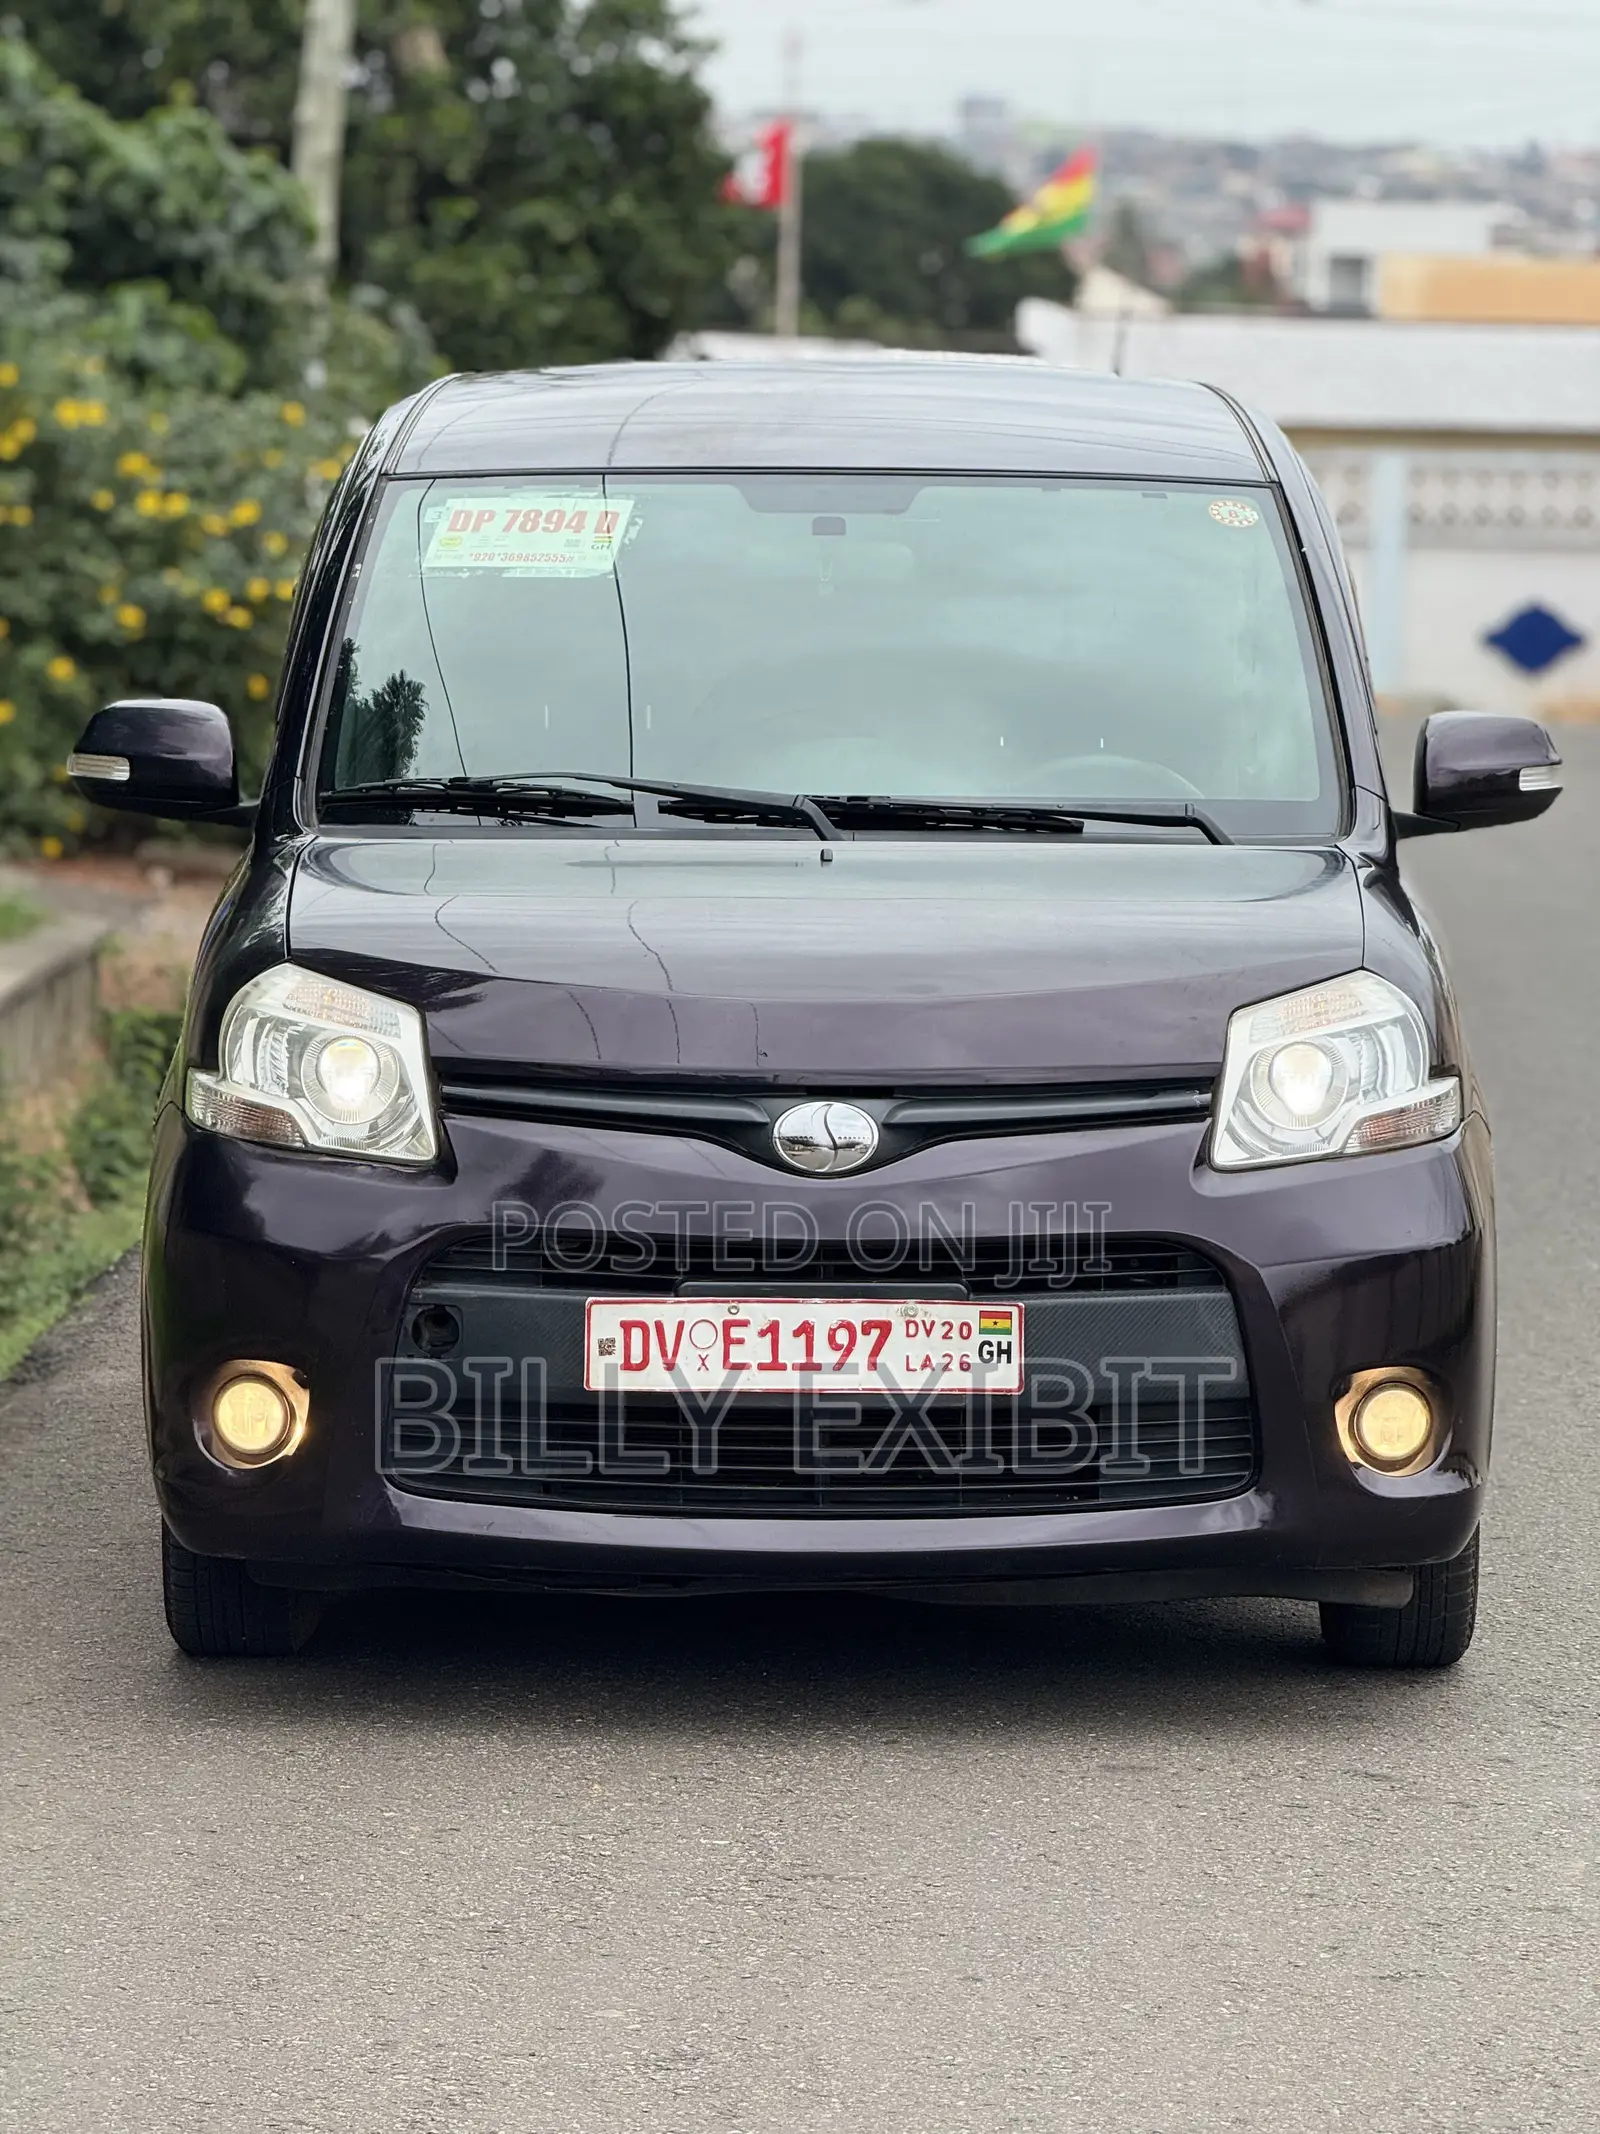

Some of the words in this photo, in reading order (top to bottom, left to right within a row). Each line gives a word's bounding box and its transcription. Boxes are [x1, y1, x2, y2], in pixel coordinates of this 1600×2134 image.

[447, 509, 496, 533] DP
[502, 509, 588, 534] 7894
[619, 1319, 686, 1372] DV
[978, 1340, 1012, 1364] GH
